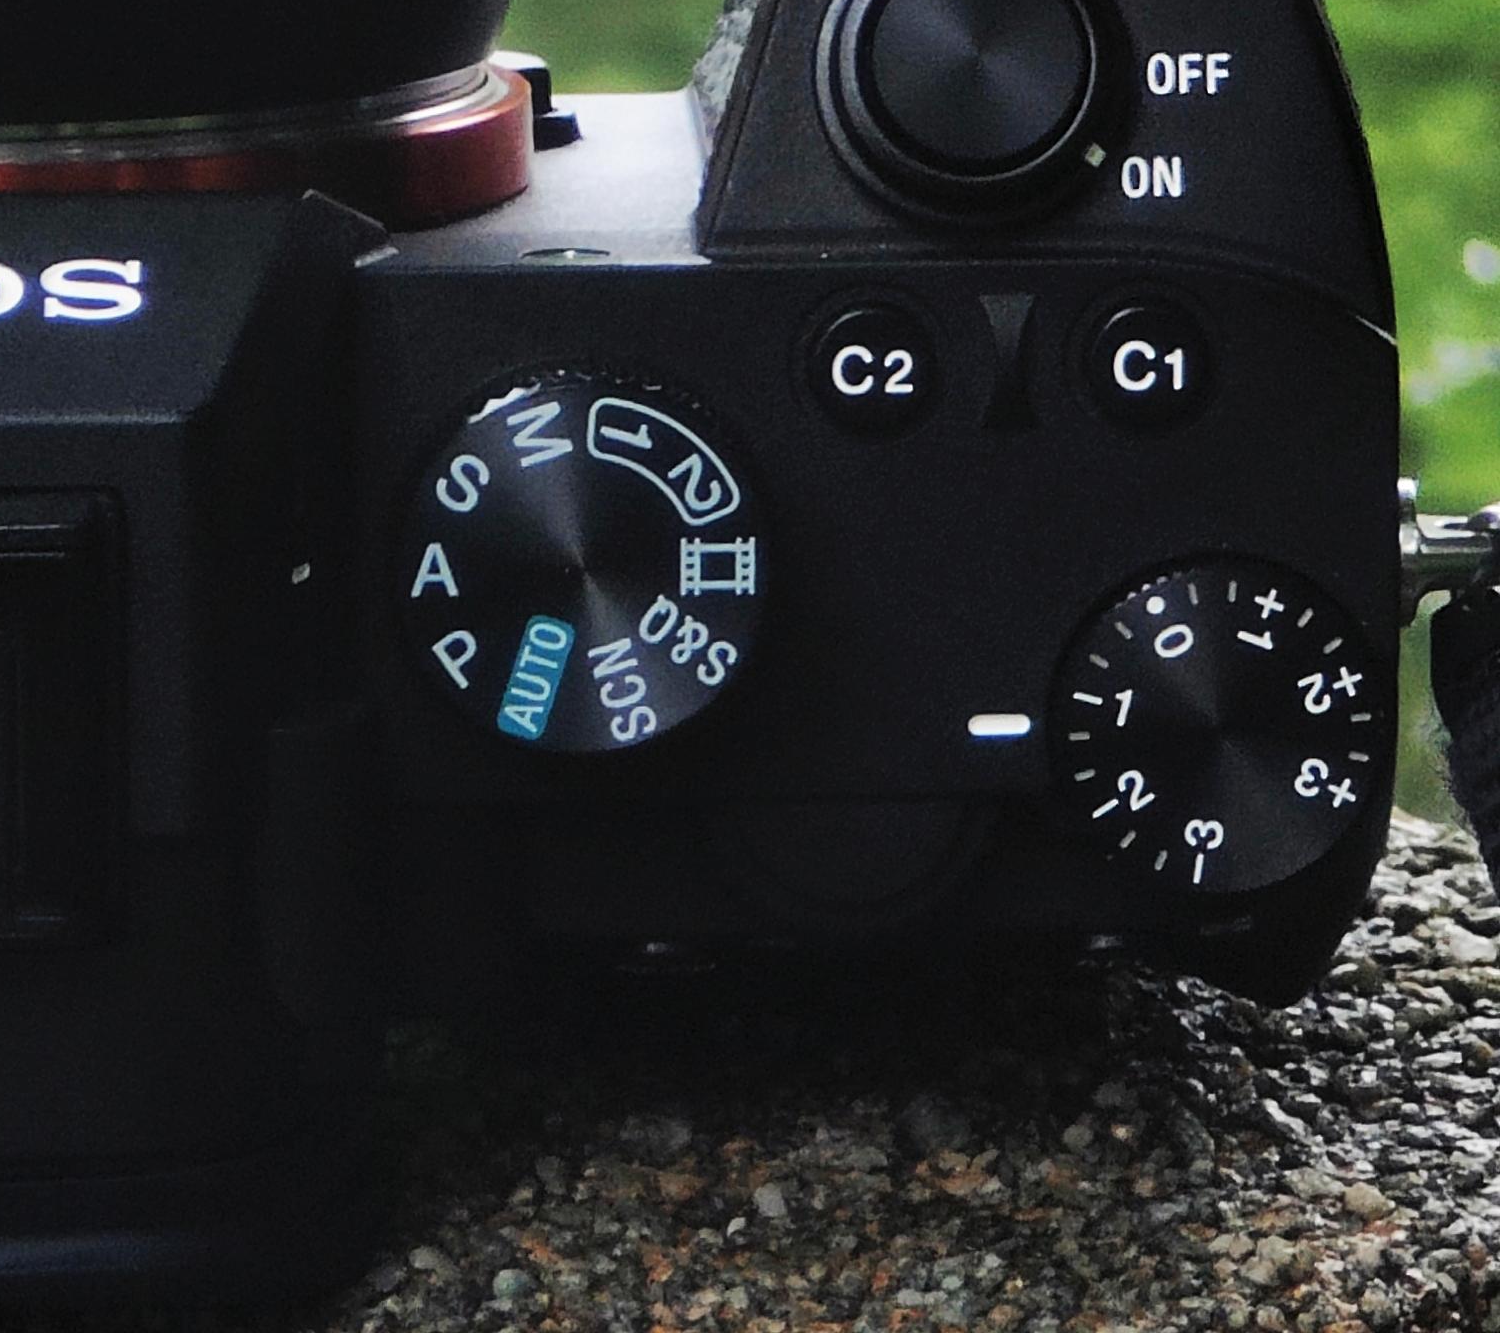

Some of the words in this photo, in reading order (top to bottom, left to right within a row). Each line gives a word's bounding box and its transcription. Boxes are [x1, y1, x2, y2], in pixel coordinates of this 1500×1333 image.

[1146, 52, 1232, 96] OFF
[1121, 155, 1185, 199] ON
[832, 345, 914, 396] C2
[1113, 340, 1184, 392] C1
[436, 454, 490, 513] S
[599, 424, 653, 449] 1
[667, 453, 722, 511] 2
[411, 543, 459, 597] A
[432, 630, 477, 689] P
[1153, 624, 1194, 659] 0
[504, 622, 568, 733] AUTO
[587, 636, 657, 742] SCN
